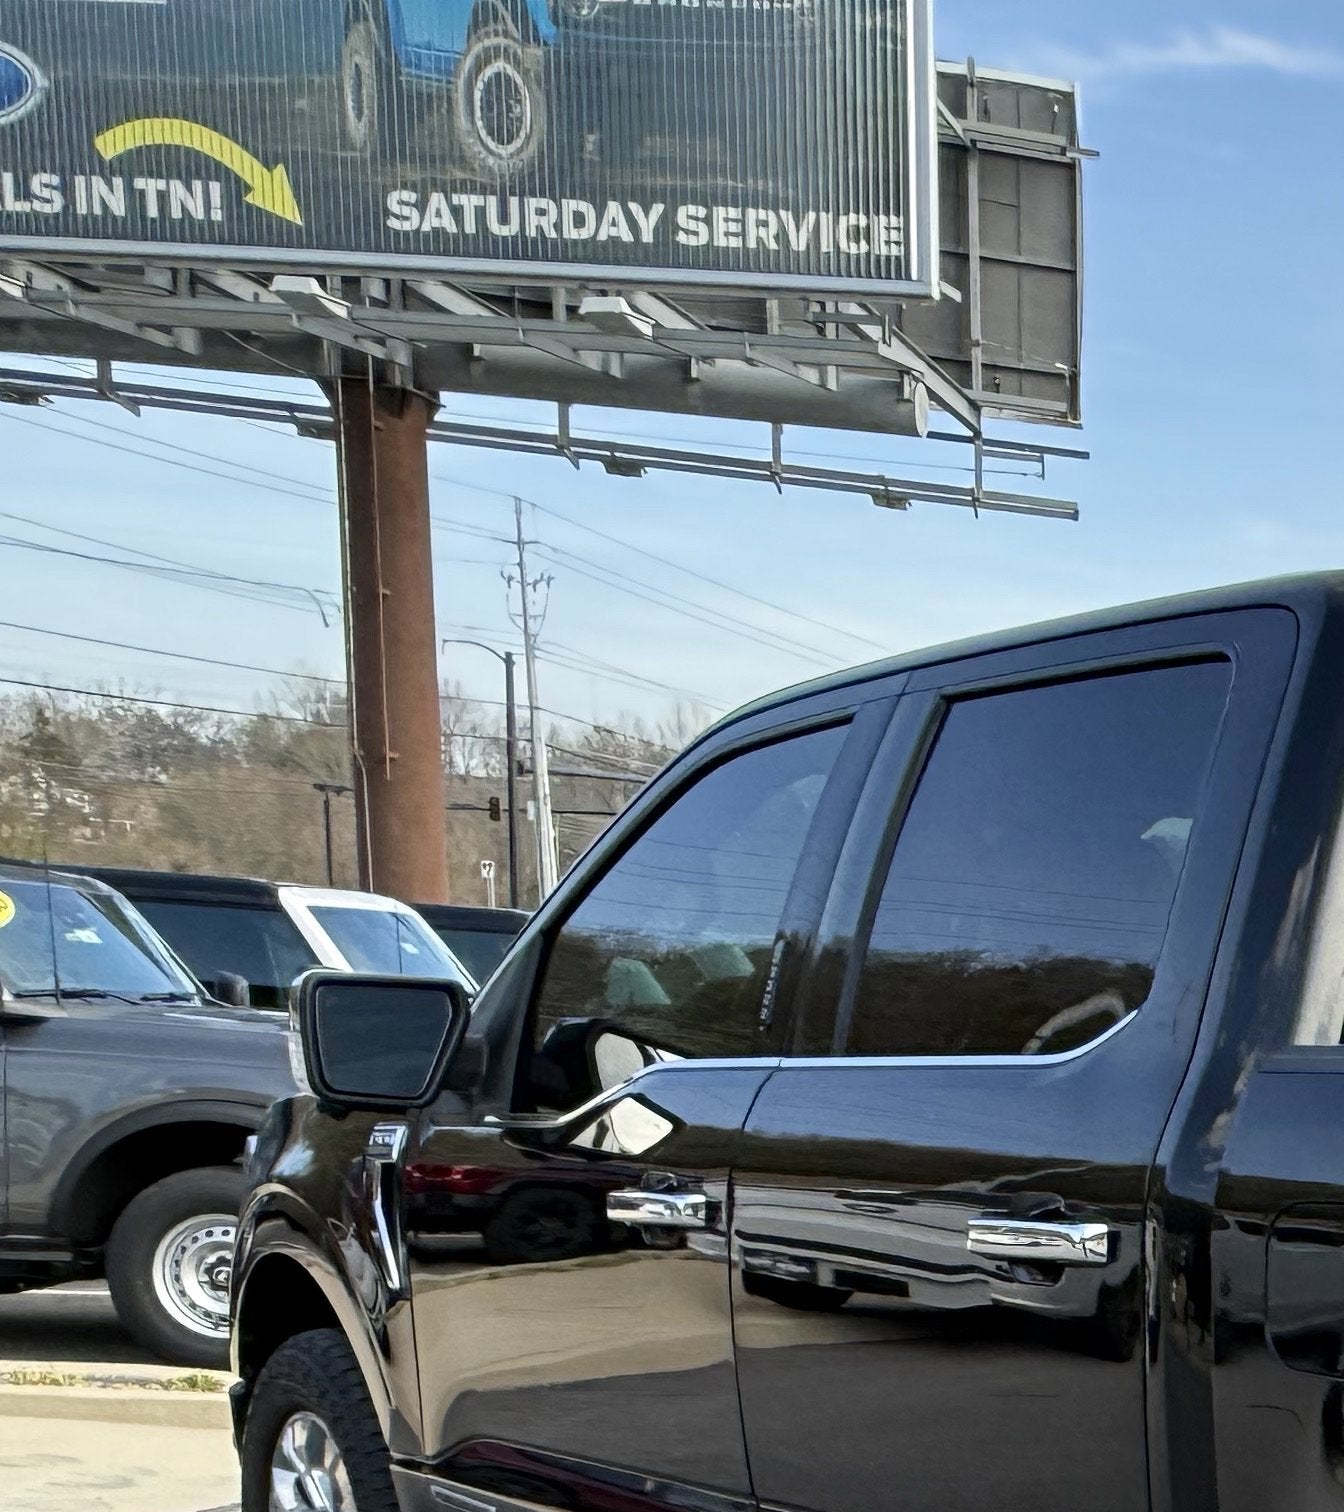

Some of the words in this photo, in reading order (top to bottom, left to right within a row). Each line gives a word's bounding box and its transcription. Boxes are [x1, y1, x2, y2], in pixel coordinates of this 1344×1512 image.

[0, 172, 64, 213] LS
[75, 175, 125, 216] IN
[134, 178, 222, 221] TN!
[386, 190, 665, 243] SATURDAY
[675, 204, 904, 255] SERVICE
